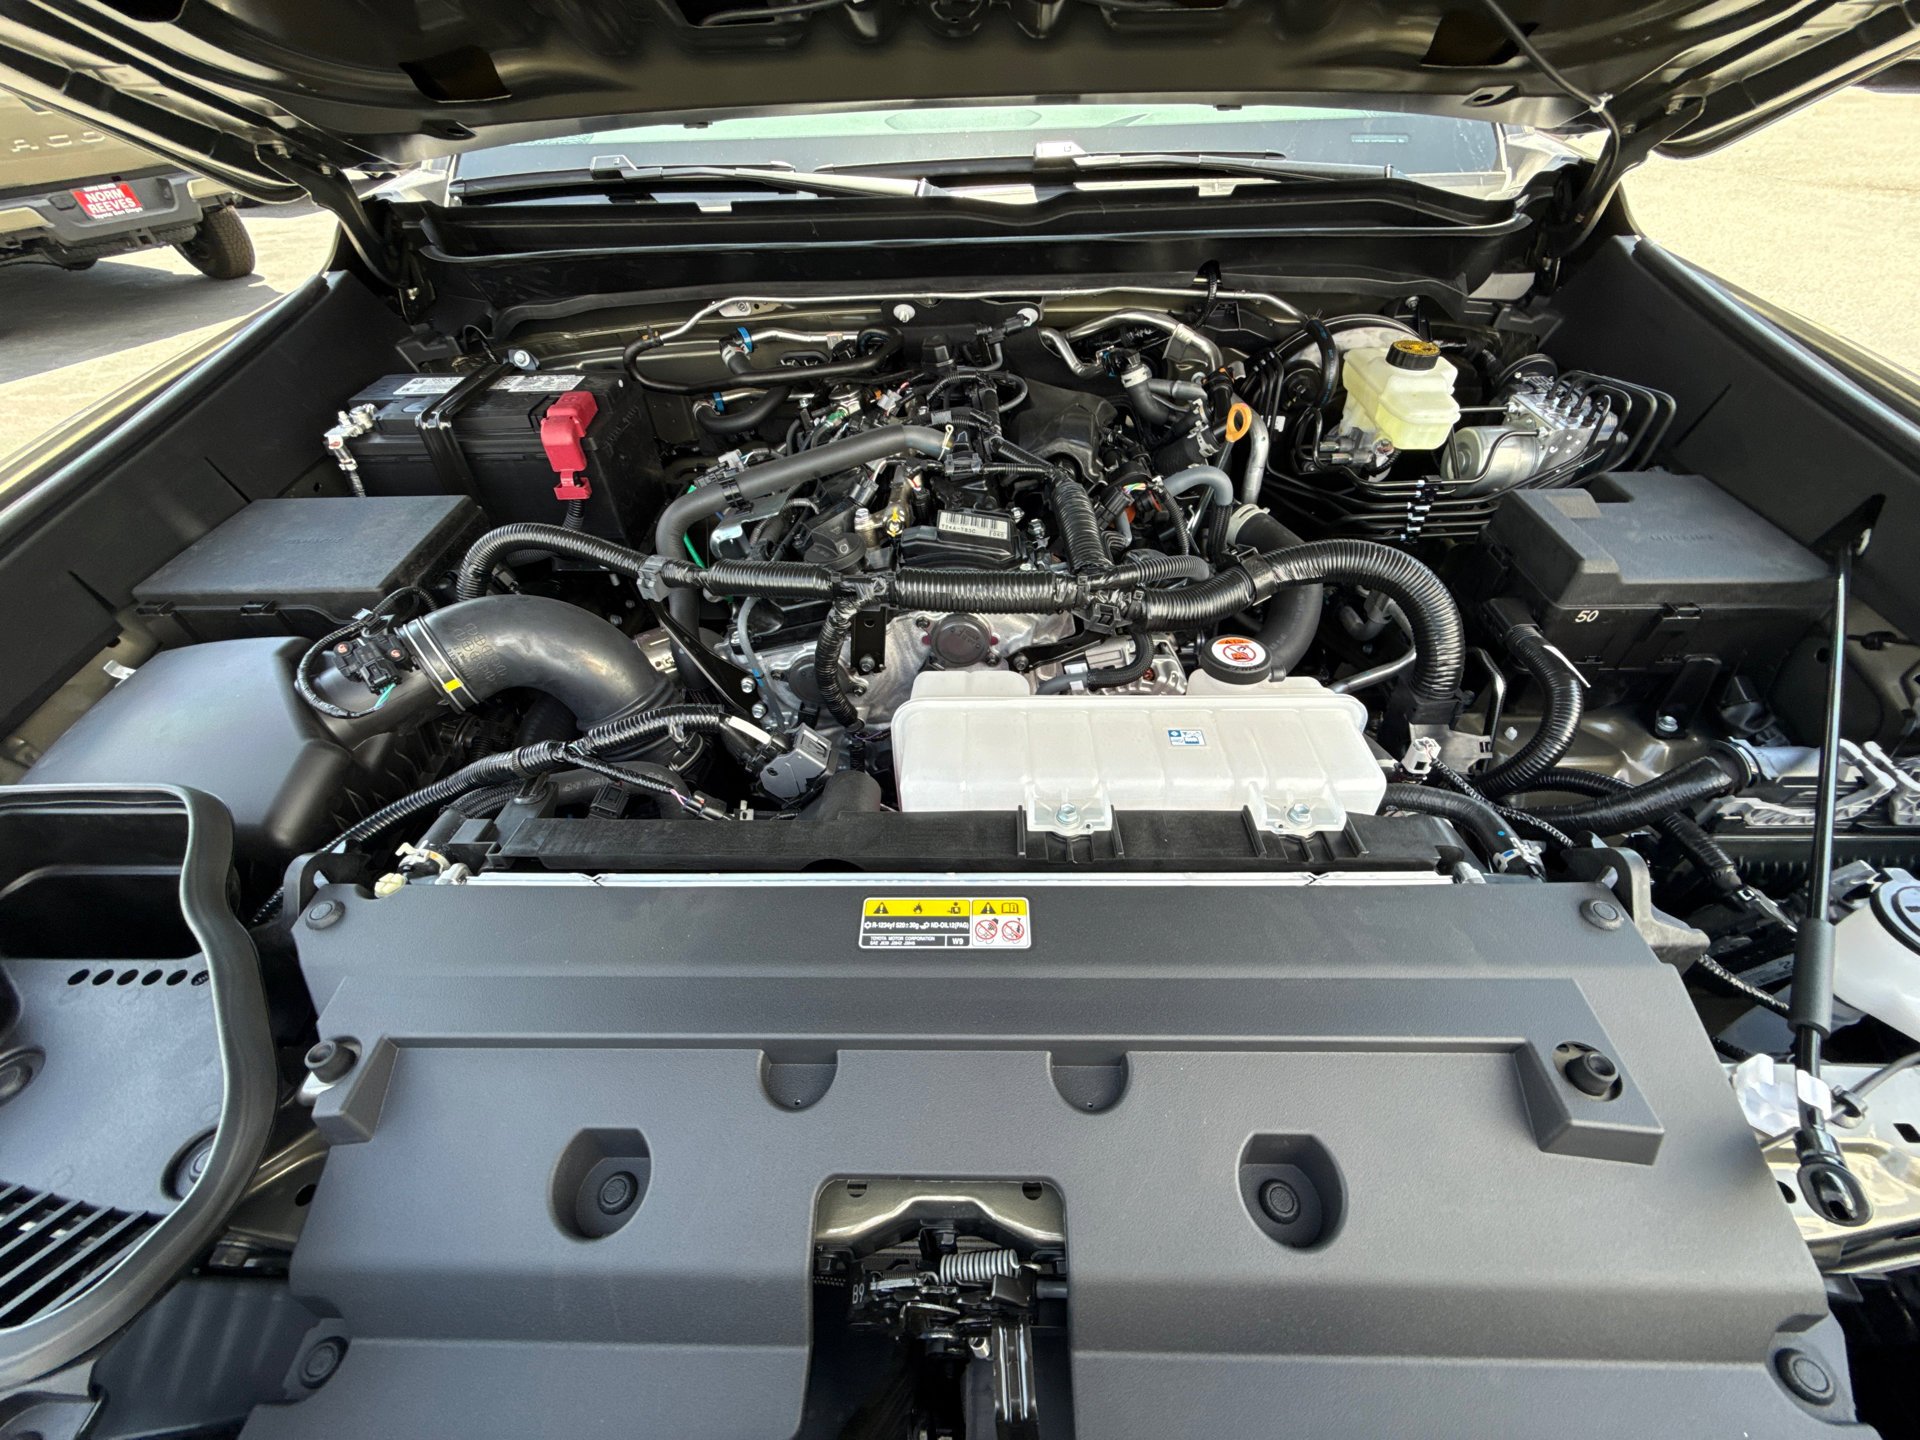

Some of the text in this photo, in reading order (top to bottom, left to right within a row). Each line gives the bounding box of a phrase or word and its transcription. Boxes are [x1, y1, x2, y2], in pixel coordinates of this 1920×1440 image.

[84, 188, 126, 203] NORM
[87, 197, 137, 214] REEVES
[1574, 610, 1599, 623] 50
[952, 937, 964, 945] W9
[852, 1283, 865, 1305] B9
